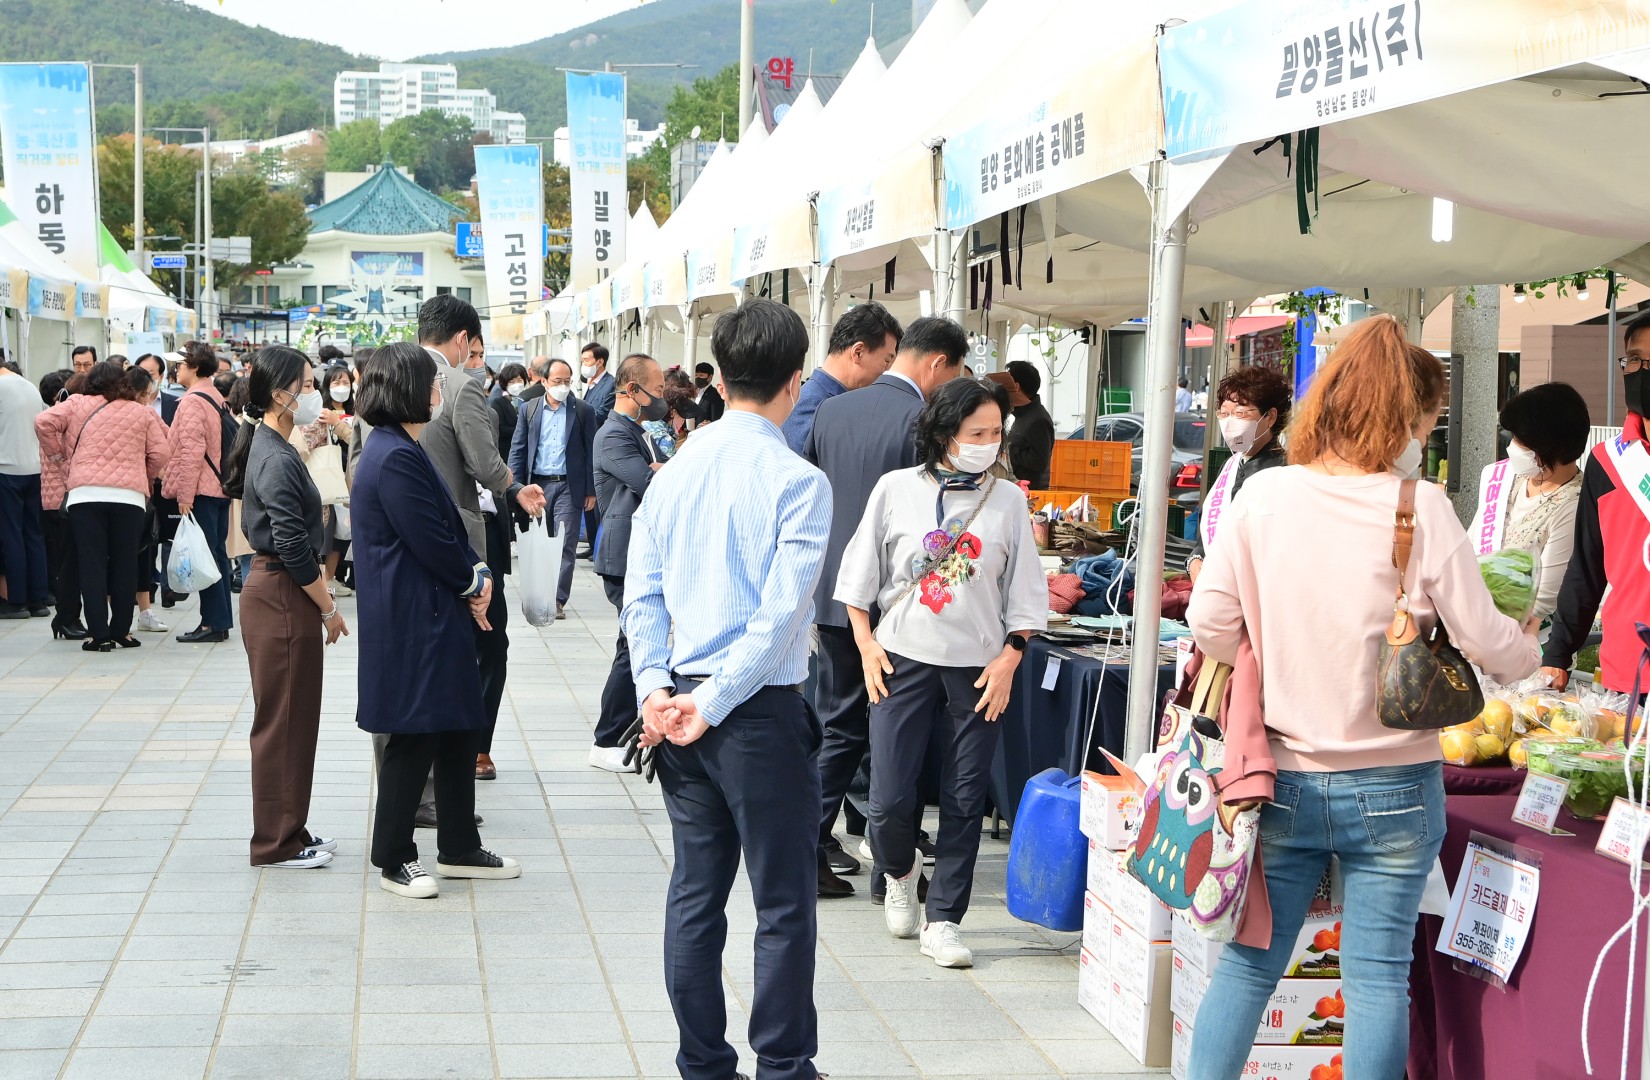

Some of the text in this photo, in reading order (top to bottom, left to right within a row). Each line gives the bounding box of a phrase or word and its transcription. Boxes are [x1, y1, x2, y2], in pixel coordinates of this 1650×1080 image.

[1276, 0, 1423, 99] 밀양물산(주)
[768, 57, 794, 89] 약
[1316, 86, 1376, 117] 경상남도 밀양시
[981, 152, 998, 194] 밀양
[1004, 131, 1044, 184] 문화예술
[1051, 112, 1084, 166] 공예품
[505, 234, 527, 314] 고성군
[1471, 883, 1526, 923] 카드결제 가능
[1472, 919, 1516, 951] 계좌이체 농협
[1290, 994, 1299, 1003] 감
[1285, 1061, 1294, 1071] 감
